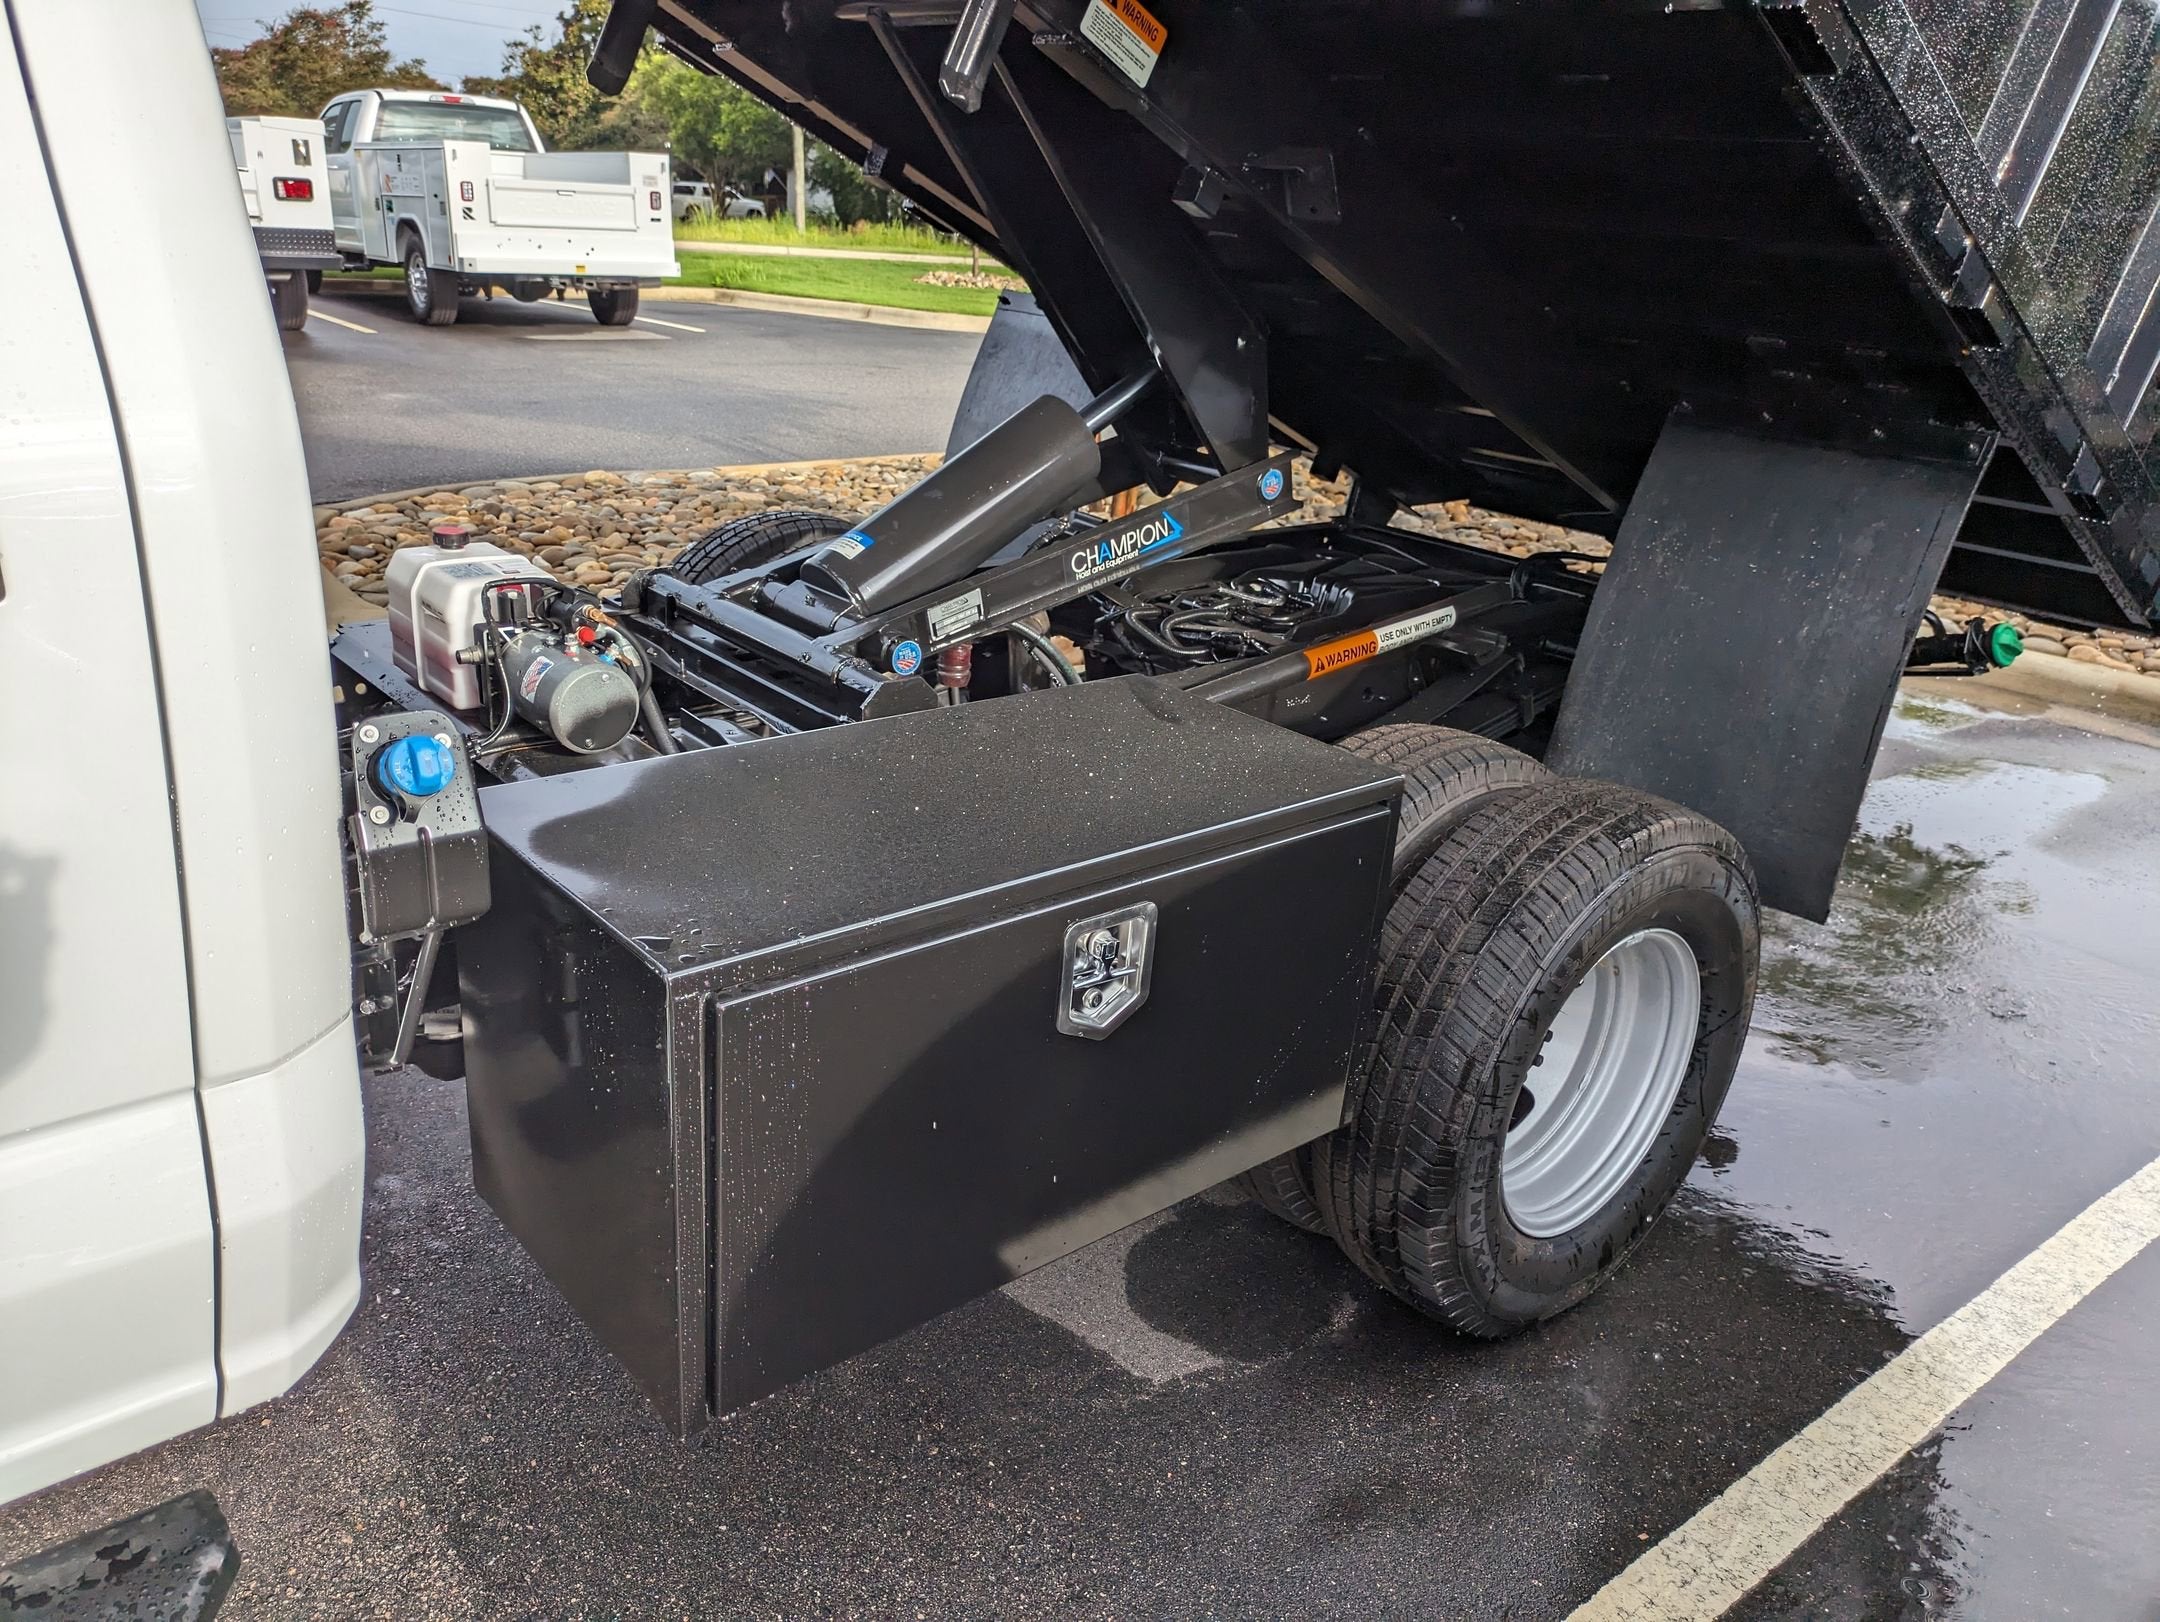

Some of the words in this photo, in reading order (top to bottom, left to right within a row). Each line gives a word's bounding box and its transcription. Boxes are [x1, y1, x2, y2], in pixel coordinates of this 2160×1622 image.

[1122, 0, 1158, 42] WARNING
[1071, 518, 1169, 573] CHAMPION
[1075, 568, 1092, 581] Hoist
[1091, 563, 1106, 574] and
[1105, 549, 1139, 569] Equipment
[1380, 629, 1394, 643] USE
[1395, 625, 1413, 639] ONLY
[1414, 619, 1431, 633] WITH
[1432, 613, 1453, 628] EMPTY
[1325, 641, 1377, 667] WARNING
